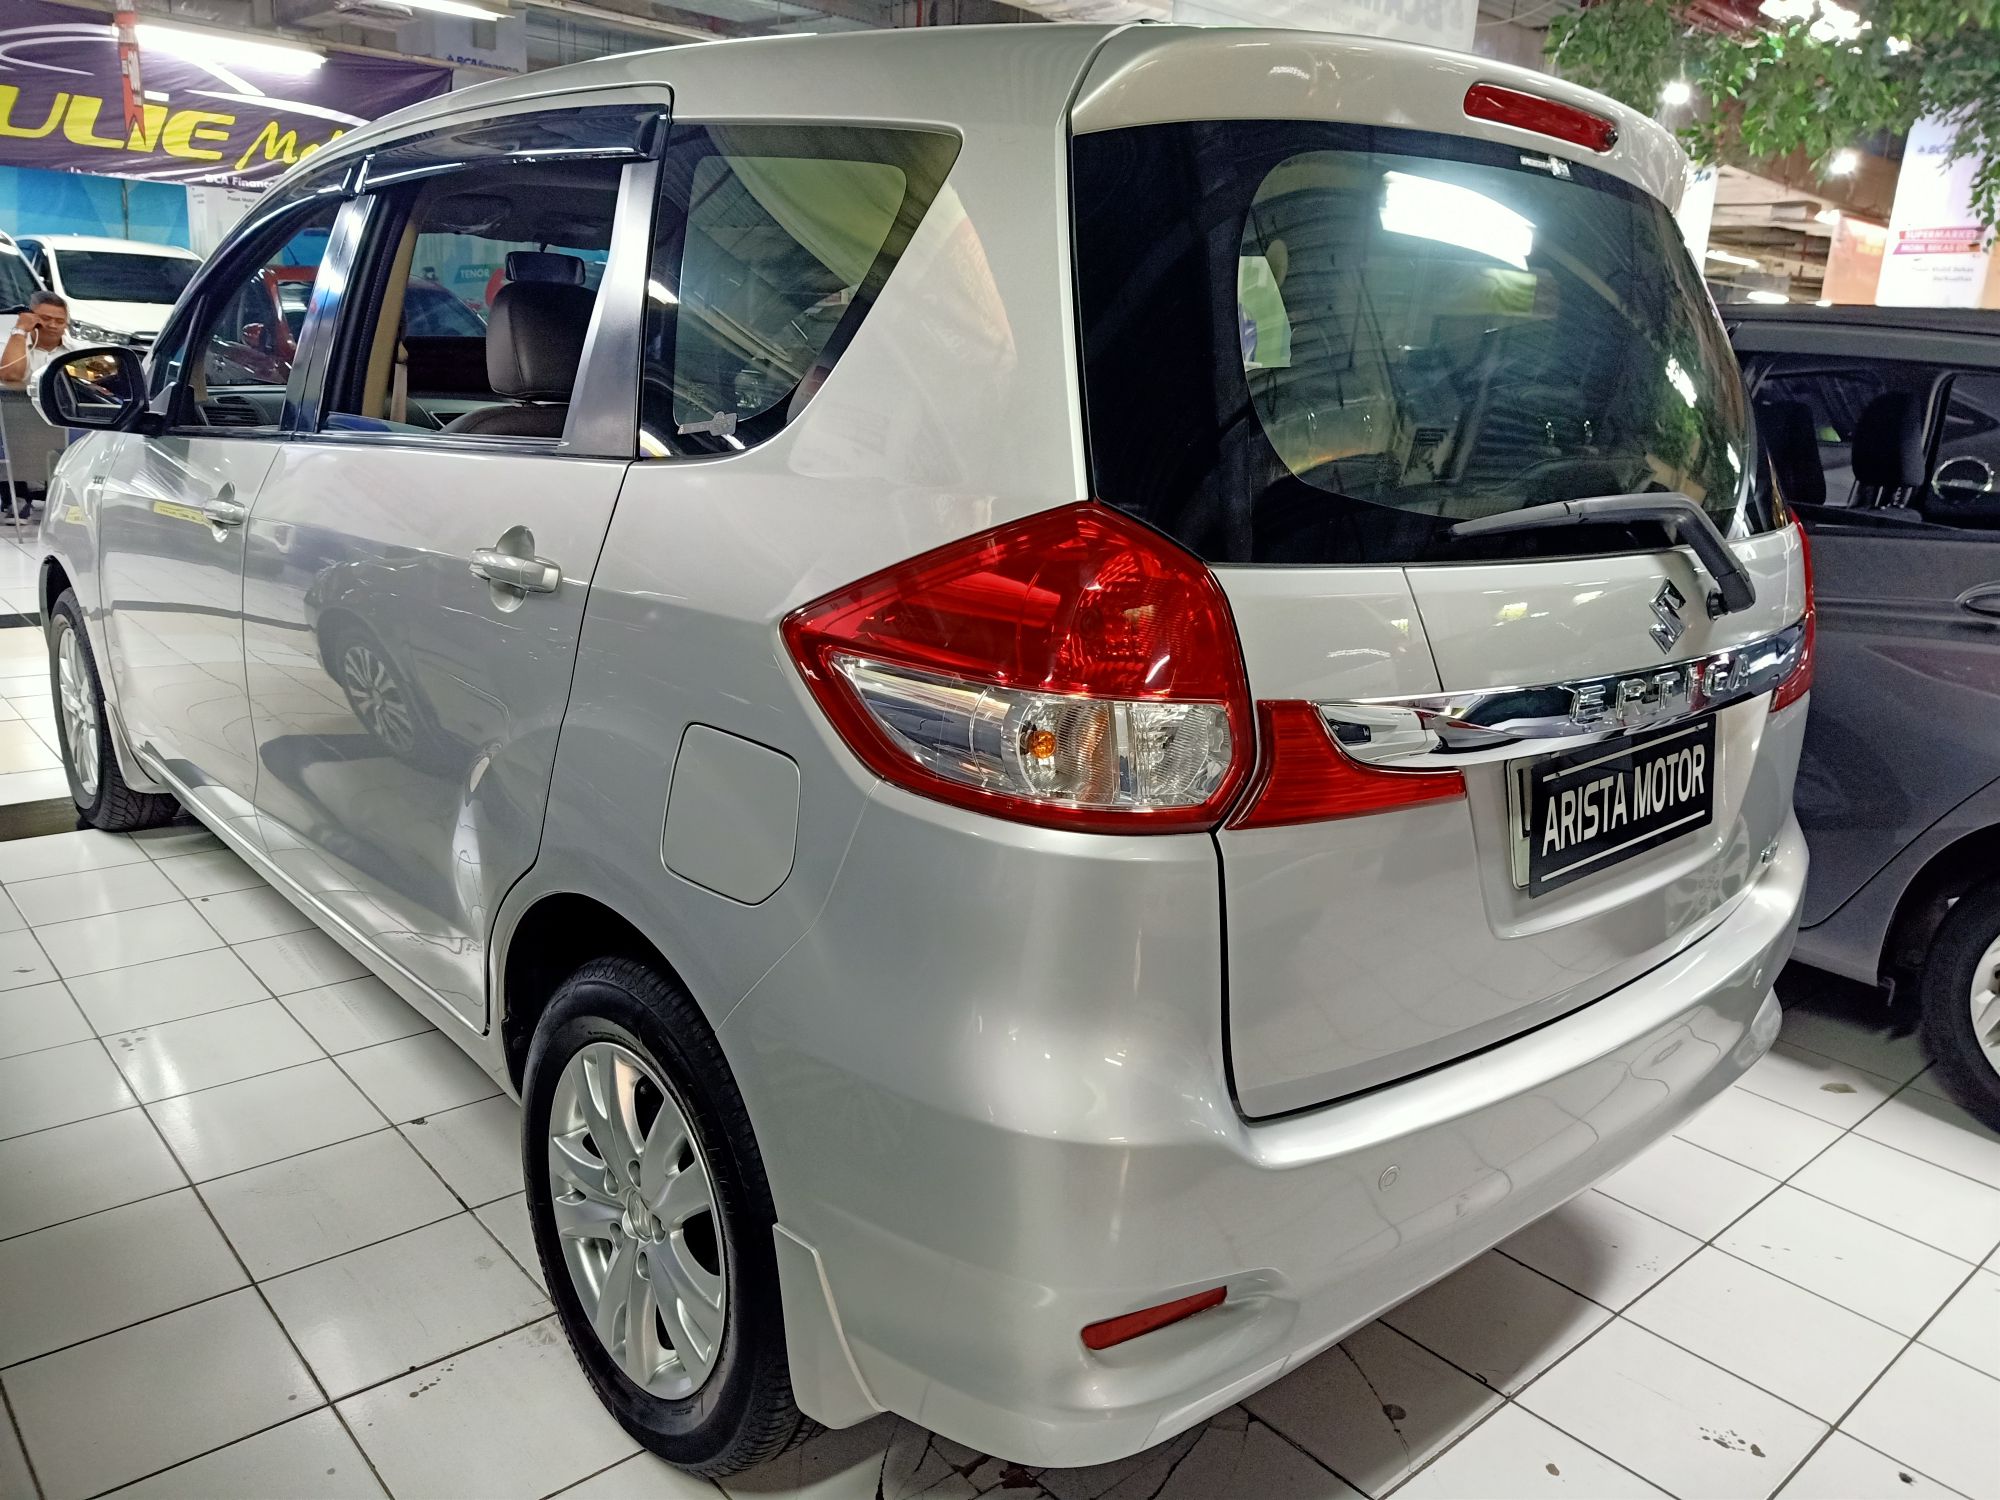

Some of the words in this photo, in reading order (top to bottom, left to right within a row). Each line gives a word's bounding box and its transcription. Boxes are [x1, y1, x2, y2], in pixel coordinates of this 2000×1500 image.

[1904, 229, 1978, 240] SUPERMARKET
[460, 268, 490, 279] TENOR
[1569, 653, 1749, 727] ERTIGA
[1541, 772, 1628, 857] ARISTA
[1633, 744, 1705, 821] MOTOR
